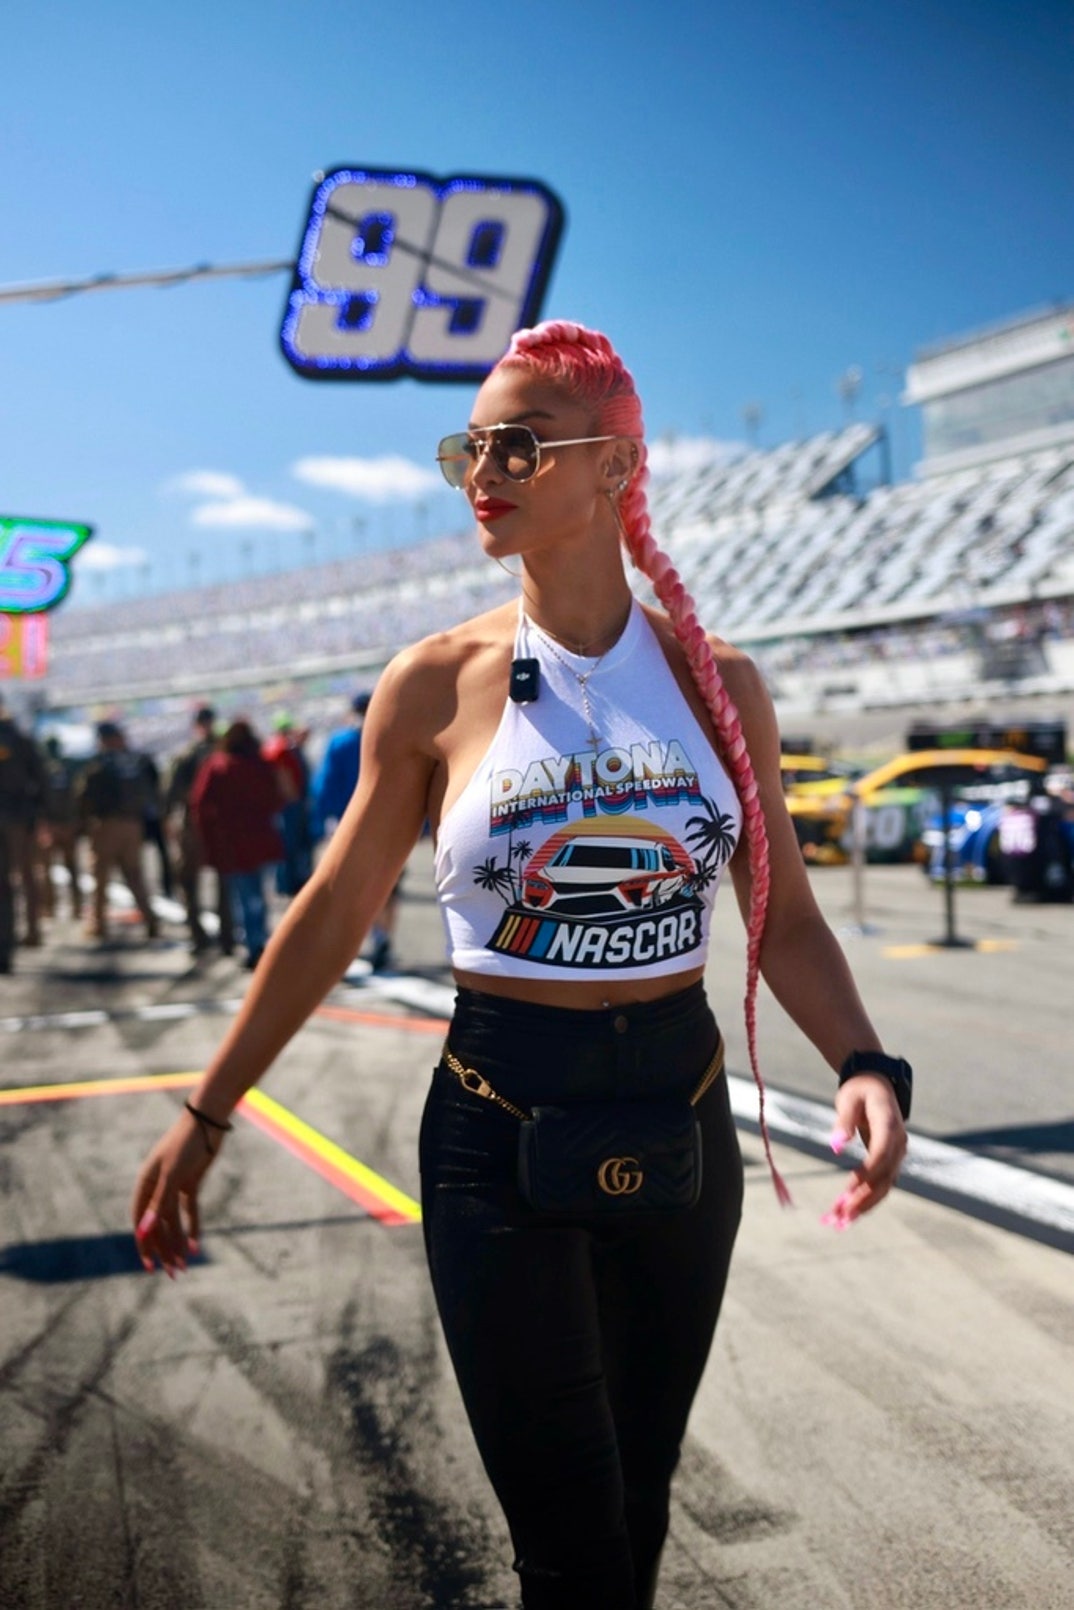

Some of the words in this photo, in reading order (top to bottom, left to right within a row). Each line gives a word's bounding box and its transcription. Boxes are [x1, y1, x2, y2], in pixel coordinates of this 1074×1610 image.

[286, 172, 552, 368] 99
[491, 739, 699, 811] DAYTONA
[492, 786, 612, 817] INTERNATIONAL
[616, 776, 696, 794] SPEEDWAY
[547, 911, 697, 964] NASCAR
